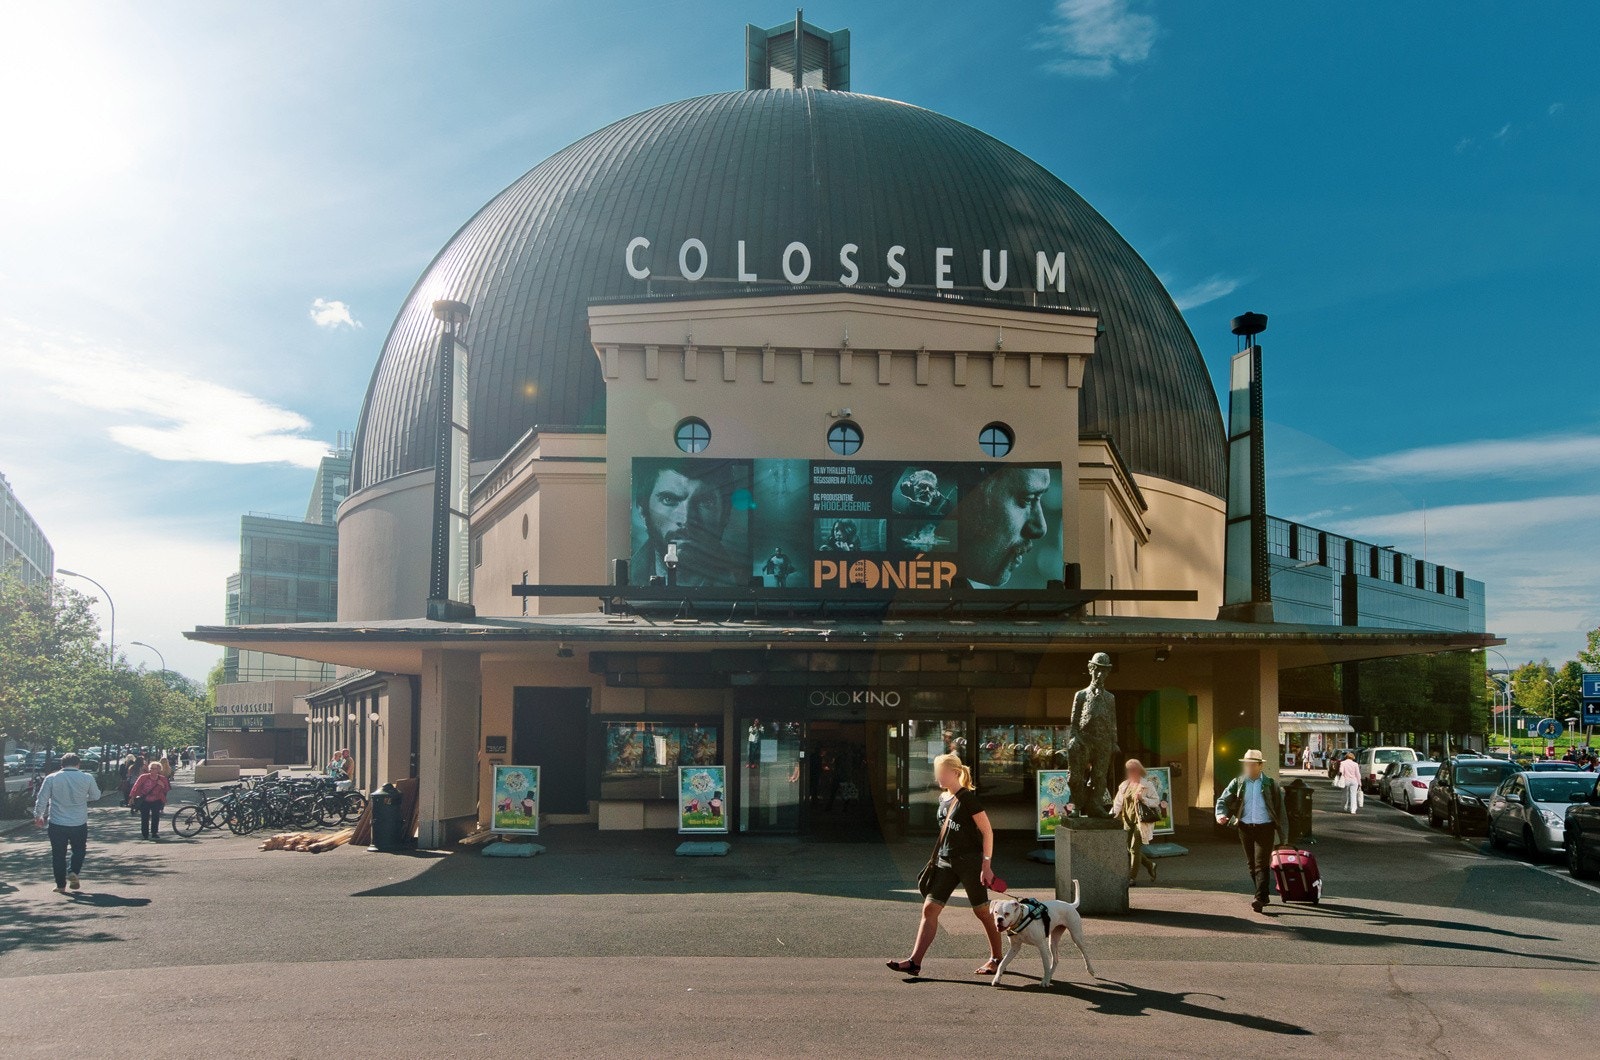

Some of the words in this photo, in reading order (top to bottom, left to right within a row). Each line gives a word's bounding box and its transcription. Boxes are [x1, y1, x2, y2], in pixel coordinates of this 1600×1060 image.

[625, 236, 1066, 293] COLOSSEUM
[814, 466, 820, 474] EN
[827, 466, 846, 474] THRILLER
[847, 466, 856, 475] FRA
[840, 476, 847, 484] AV
[847, 475, 873, 485] NOKAS
[814, 493, 820, 501] OG
[821, 493, 854, 501] PRODUSENTENE
[813, 503, 820, 511] AV
[821, 501, 872, 511] HODEJEGERNE
[814, 553, 957, 589] PIONÉR
[810, 691, 850, 706] OSLO
[853, 691, 900, 707] KINO
[231, 703, 273, 714] COLOSSEUM
